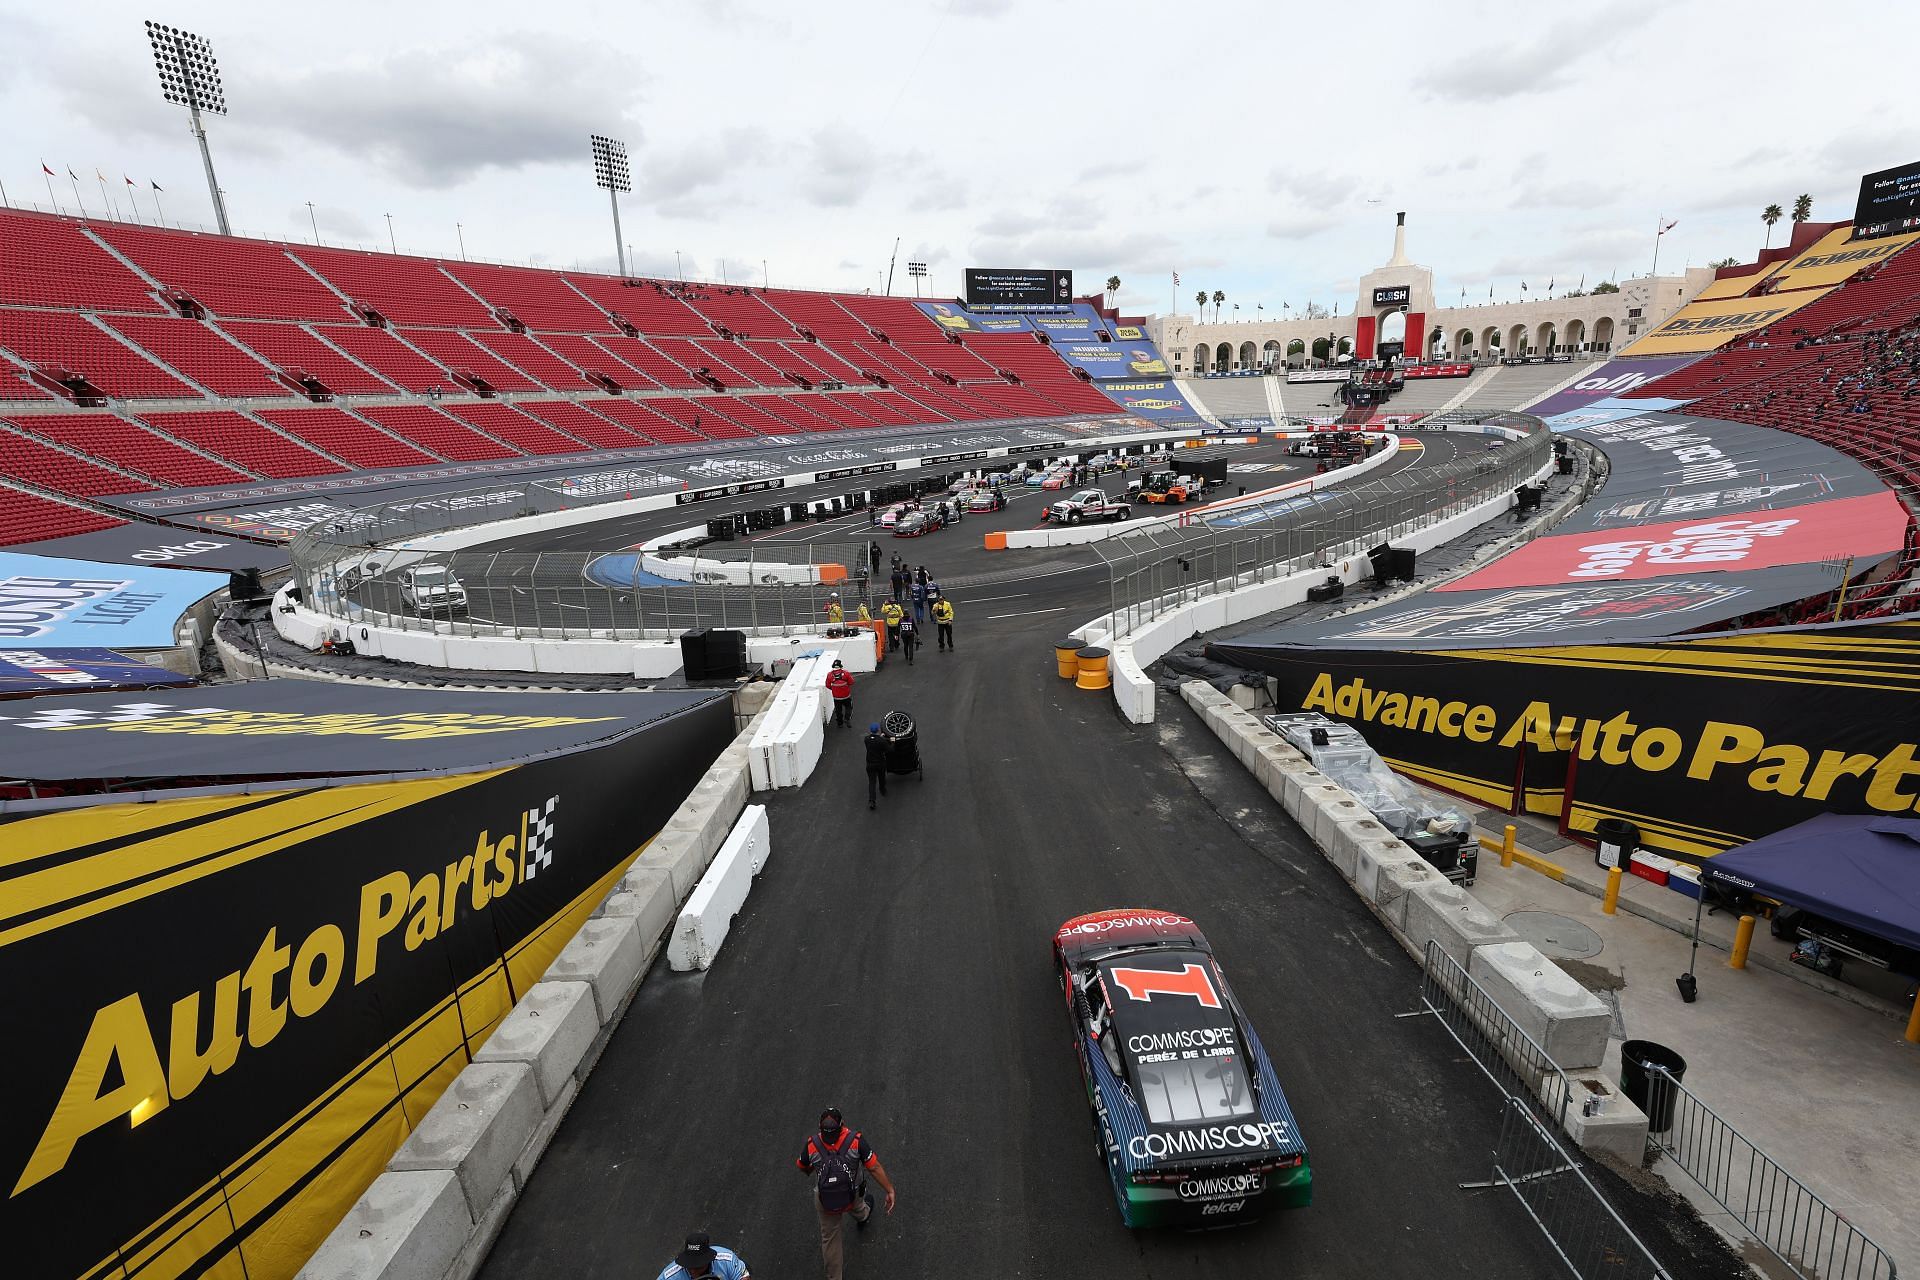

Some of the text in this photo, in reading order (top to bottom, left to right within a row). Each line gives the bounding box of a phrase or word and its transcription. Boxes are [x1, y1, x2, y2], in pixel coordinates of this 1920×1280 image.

[1874, 180, 1895, 188] Follow
[1859, 225, 1879, 235] Mobil
[1792, 241, 1907, 270] DEWALT
[1376, 290, 1407, 302] CLASH
[1659, 307, 1789, 331] DEWALT
[1106, 383, 1165, 391] SUNOCO
[1574, 372, 1666, 394] ally
[235, 503, 333, 520] NASCAR
[131, 540, 231, 561] okta
[72, 591, 167, 625] LIGHT
[107, 721, 526, 740] Advance
[400, 713, 626, 728] Auto
[1302, 672, 1920, 813] Advance Auto Part
[1713, 870, 1756, 888] Academy
[1060, 915, 1194, 937] COMMSCOPE
[1110, 963, 1224, 1009] 1
[9, 829, 517, 1199] Auto Parts
[1129, 1028, 1235, 1053] COMMSCOPE
[1138, 1047, 1236, 1064] PERÉZ DE LARA
[1094, 1083, 1121, 1153] telcel
[1129, 1121, 1288, 1159] COMMSCOPE
[1179, 1173, 1260, 1197] COMMSCOPE
[1202, 1199, 1246, 1215] telcel
